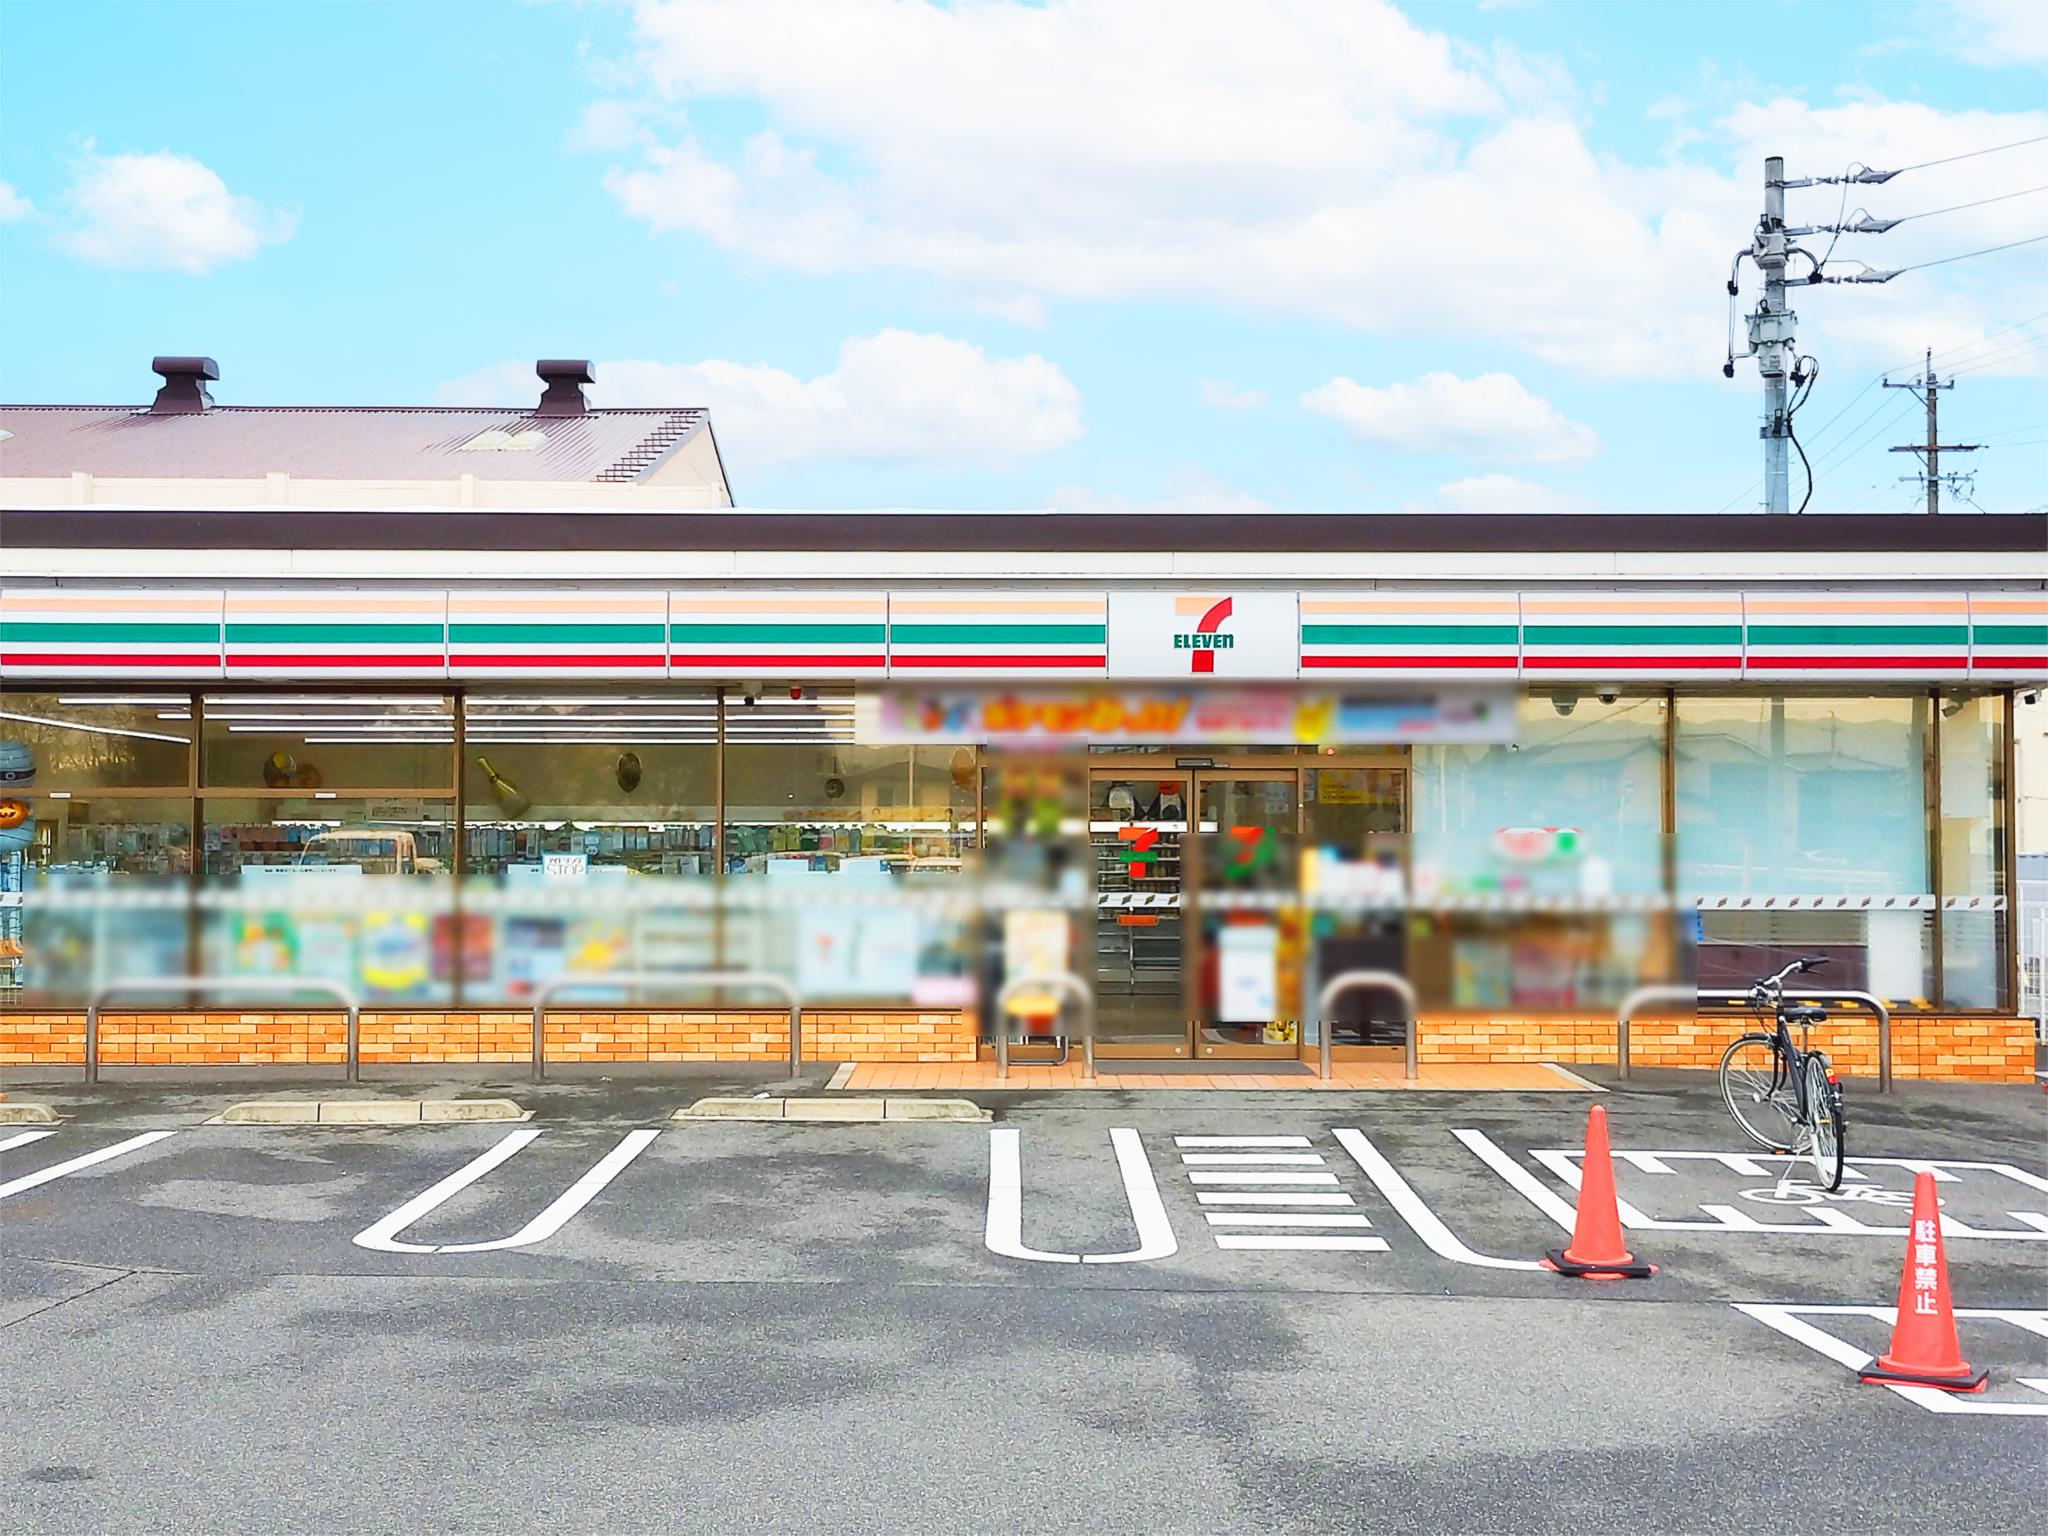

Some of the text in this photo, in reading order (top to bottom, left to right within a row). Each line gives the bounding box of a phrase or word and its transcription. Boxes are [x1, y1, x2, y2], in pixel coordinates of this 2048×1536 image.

[1174, 596, 1232, 673] 7
[1915, 1220, 1938, 1315] 駐車禁止
